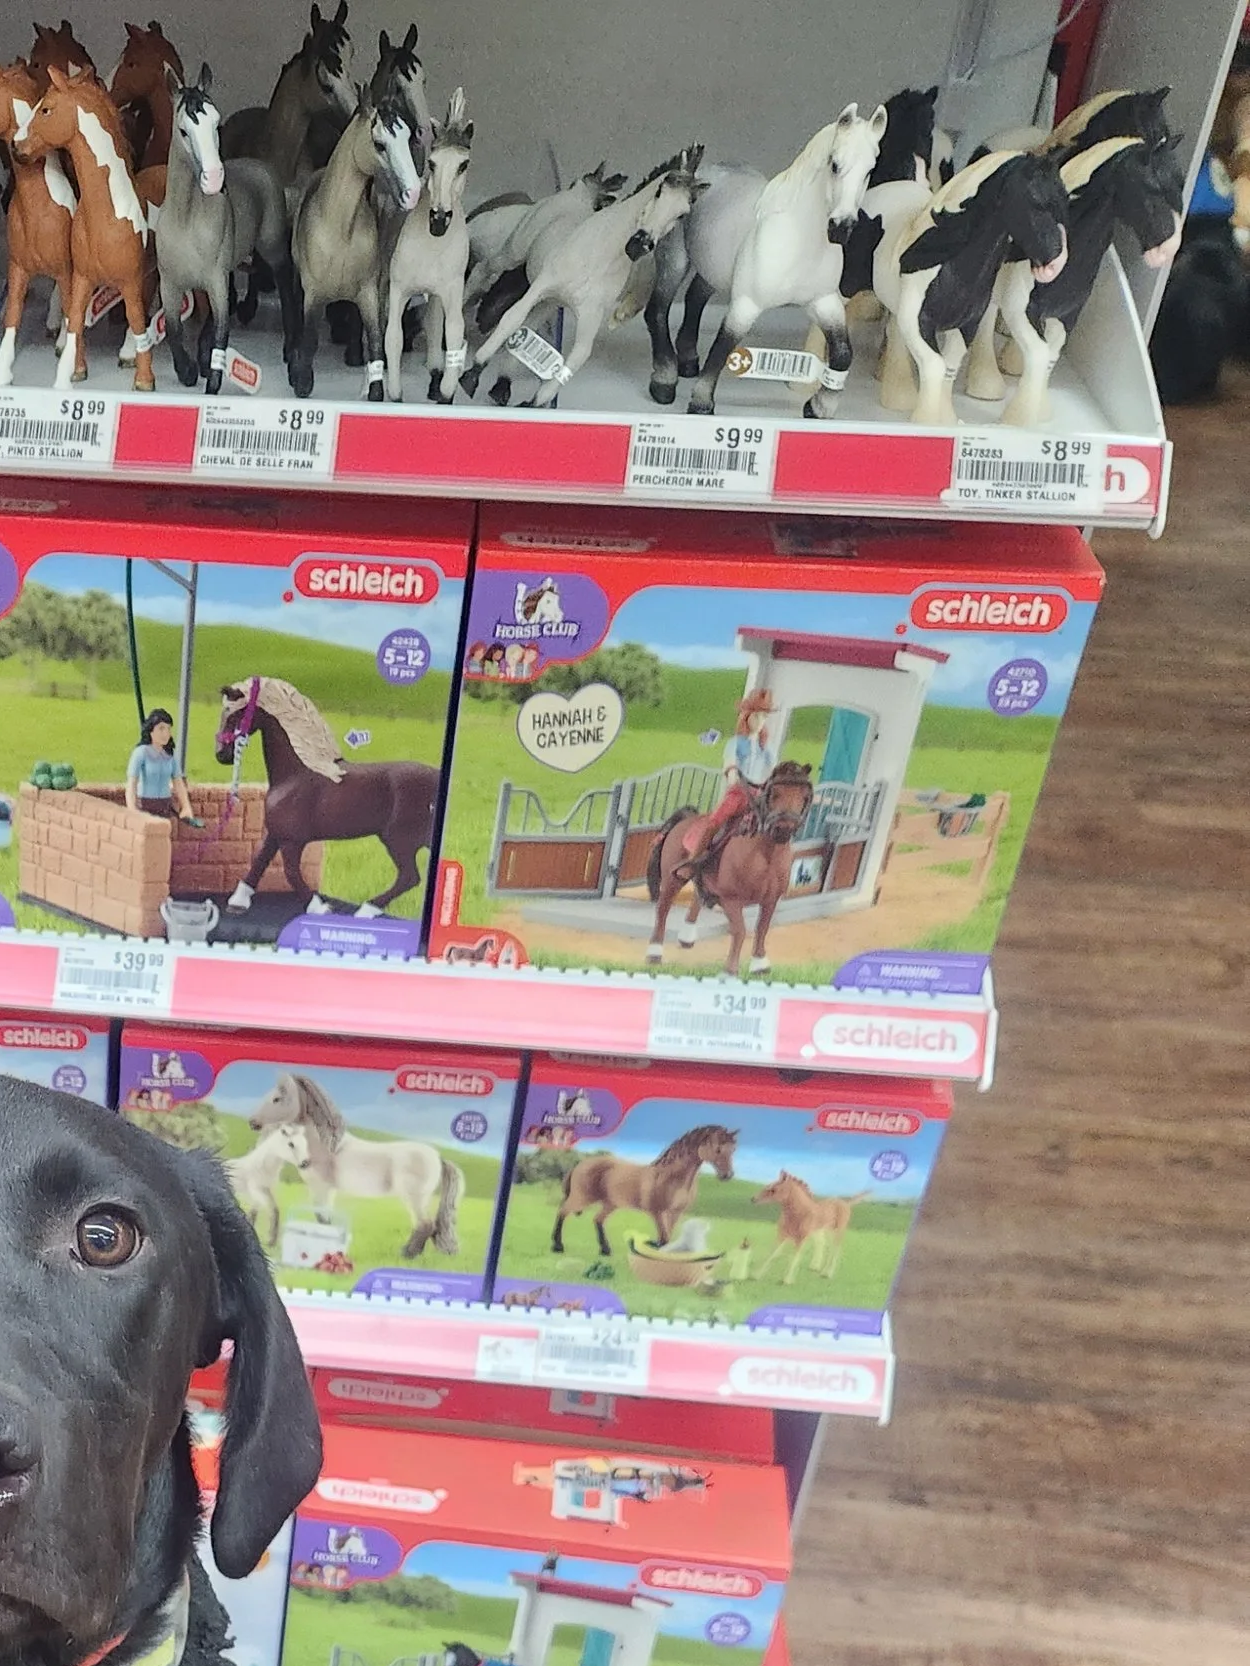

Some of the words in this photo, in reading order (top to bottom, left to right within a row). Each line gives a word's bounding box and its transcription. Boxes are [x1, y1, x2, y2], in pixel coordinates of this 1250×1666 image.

[729, 352, 751, 371] 3+
[8, 446, 35, 456] PINTO
[39, 447, 84, 459] STALLION
[200, 455, 236, 466] CHEVAL
[240, 457, 251, 466] DE
[256, 457, 284, 468] SELLE
[287, 460, 314, 470] FRAN
[633, 474, 693, 487] PERCHERON
[696, 477, 726, 489] MARE
[985, 489, 1022, 500] TINKER
[1026, 490, 1077, 501] STALLION
[308, 563, 424, 598] schleich
[925, 593, 1052, 627] schleich
[495, 623, 541, 639] HORSE
[543, 621, 580, 638] CLUB
[382, 647, 426, 667] 5-12
[994, 678, 1040, 697] 5-12
[532, 707, 593, 731] HANNAH
[536, 726, 605, 749] CAYENNE
[2, 1028, 79, 1049] schleich
[833, 1021, 958, 1053] schleich
[404, 1072, 486, 1097] schleich
[824, 1110, 913, 1133] schleich
[746, 1364, 859, 1394] schleich
[650, 1569, 752, 1598] schleich
